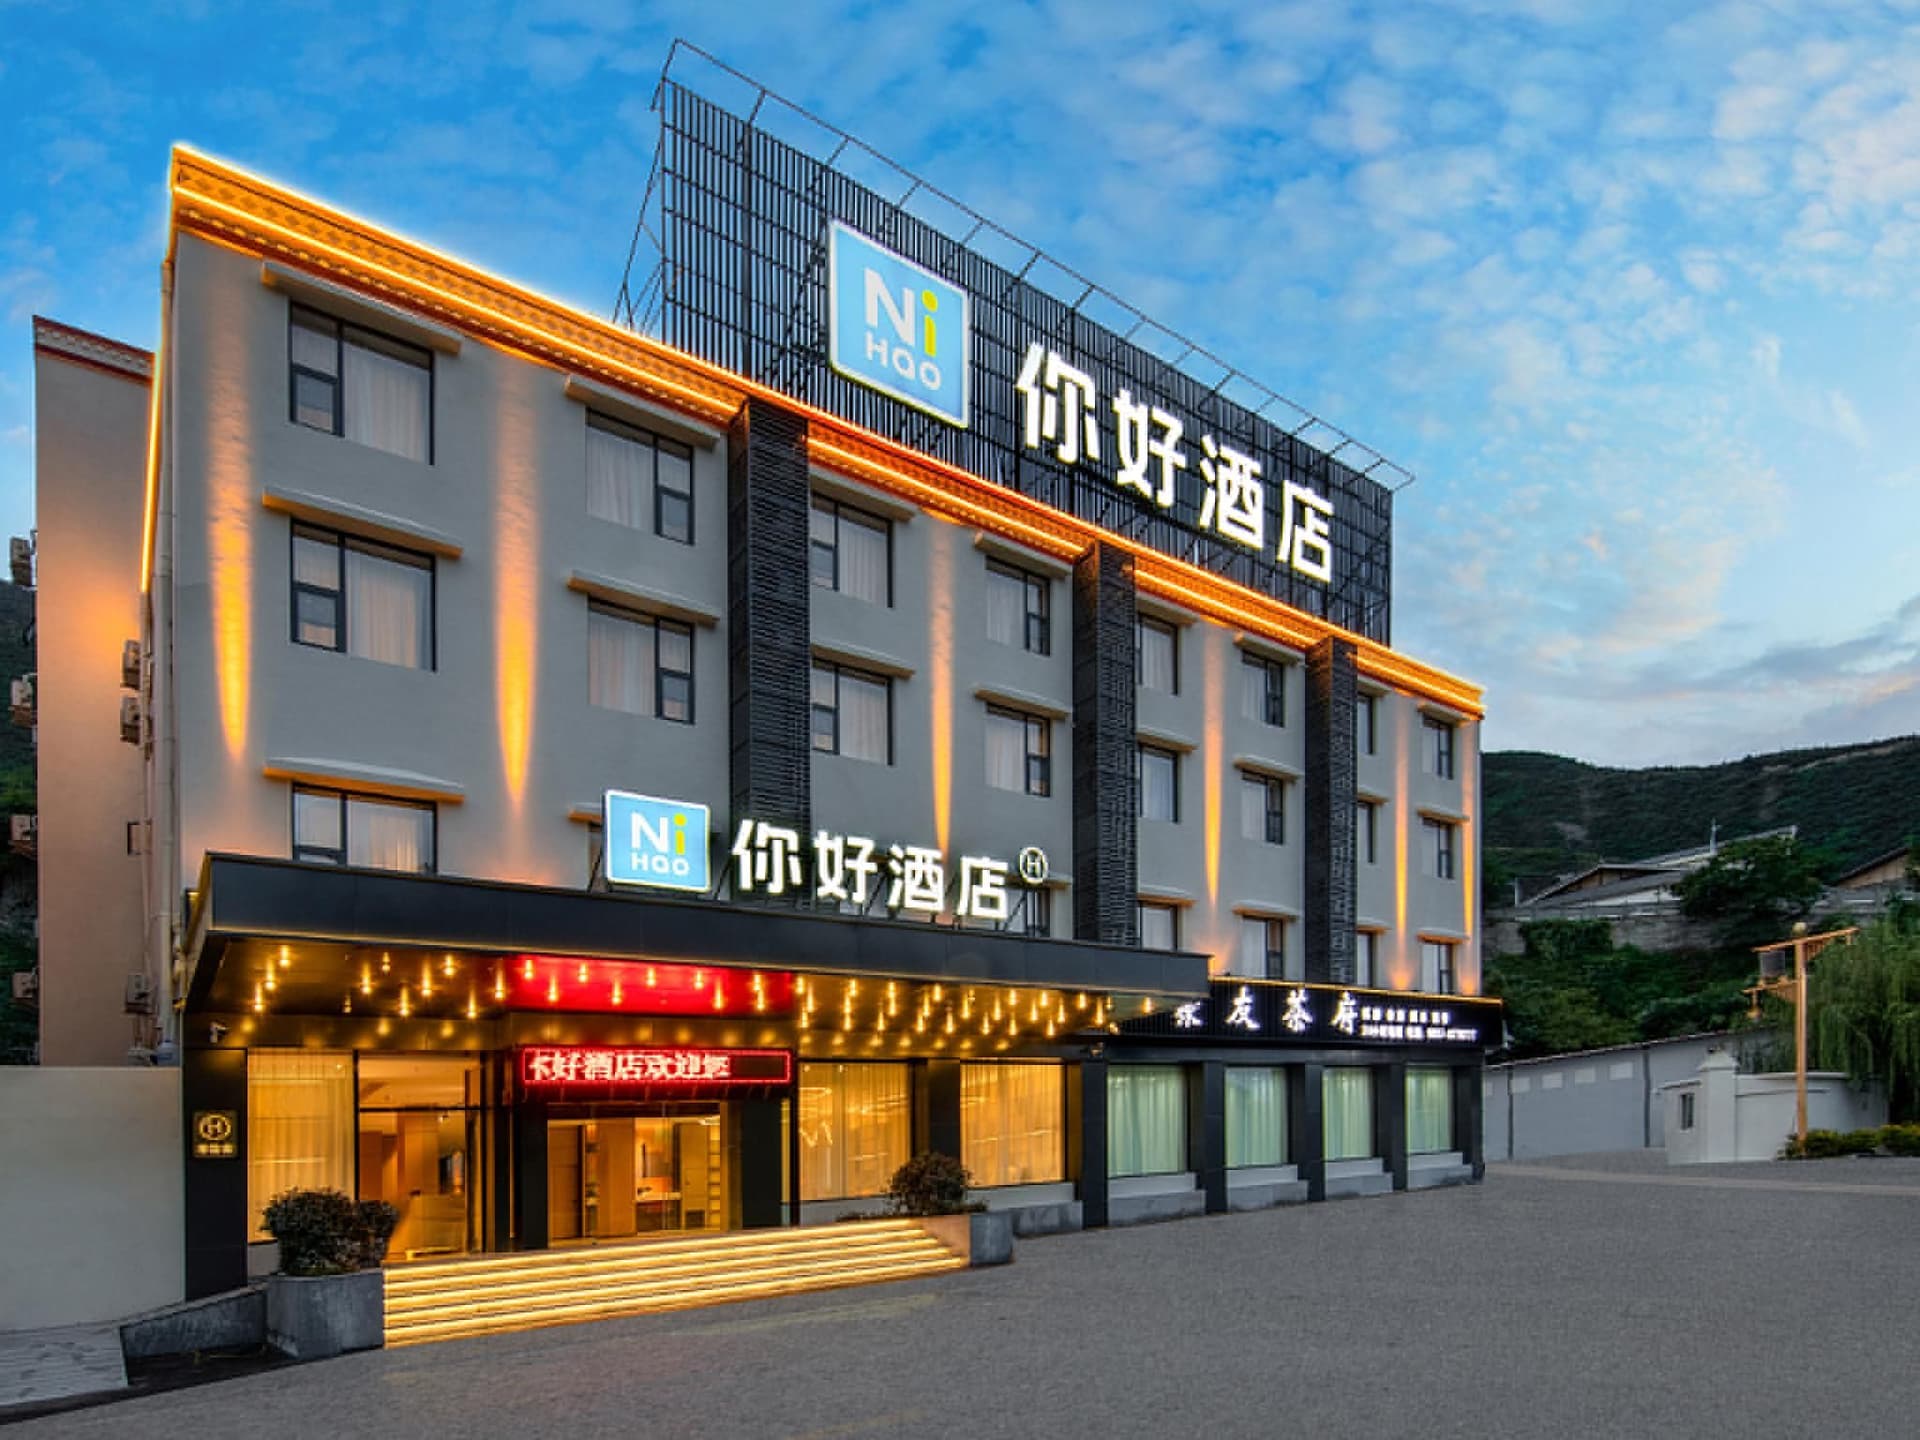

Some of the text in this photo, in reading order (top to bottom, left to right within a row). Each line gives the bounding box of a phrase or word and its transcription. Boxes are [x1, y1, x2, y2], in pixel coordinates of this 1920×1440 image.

[863, 268, 938, 357] Ni
[1015, 342, 1335, 584] 你好酒店
[631, 812, 687, 855] Ni
[731, 819, 1010, 921] 你好酒店
